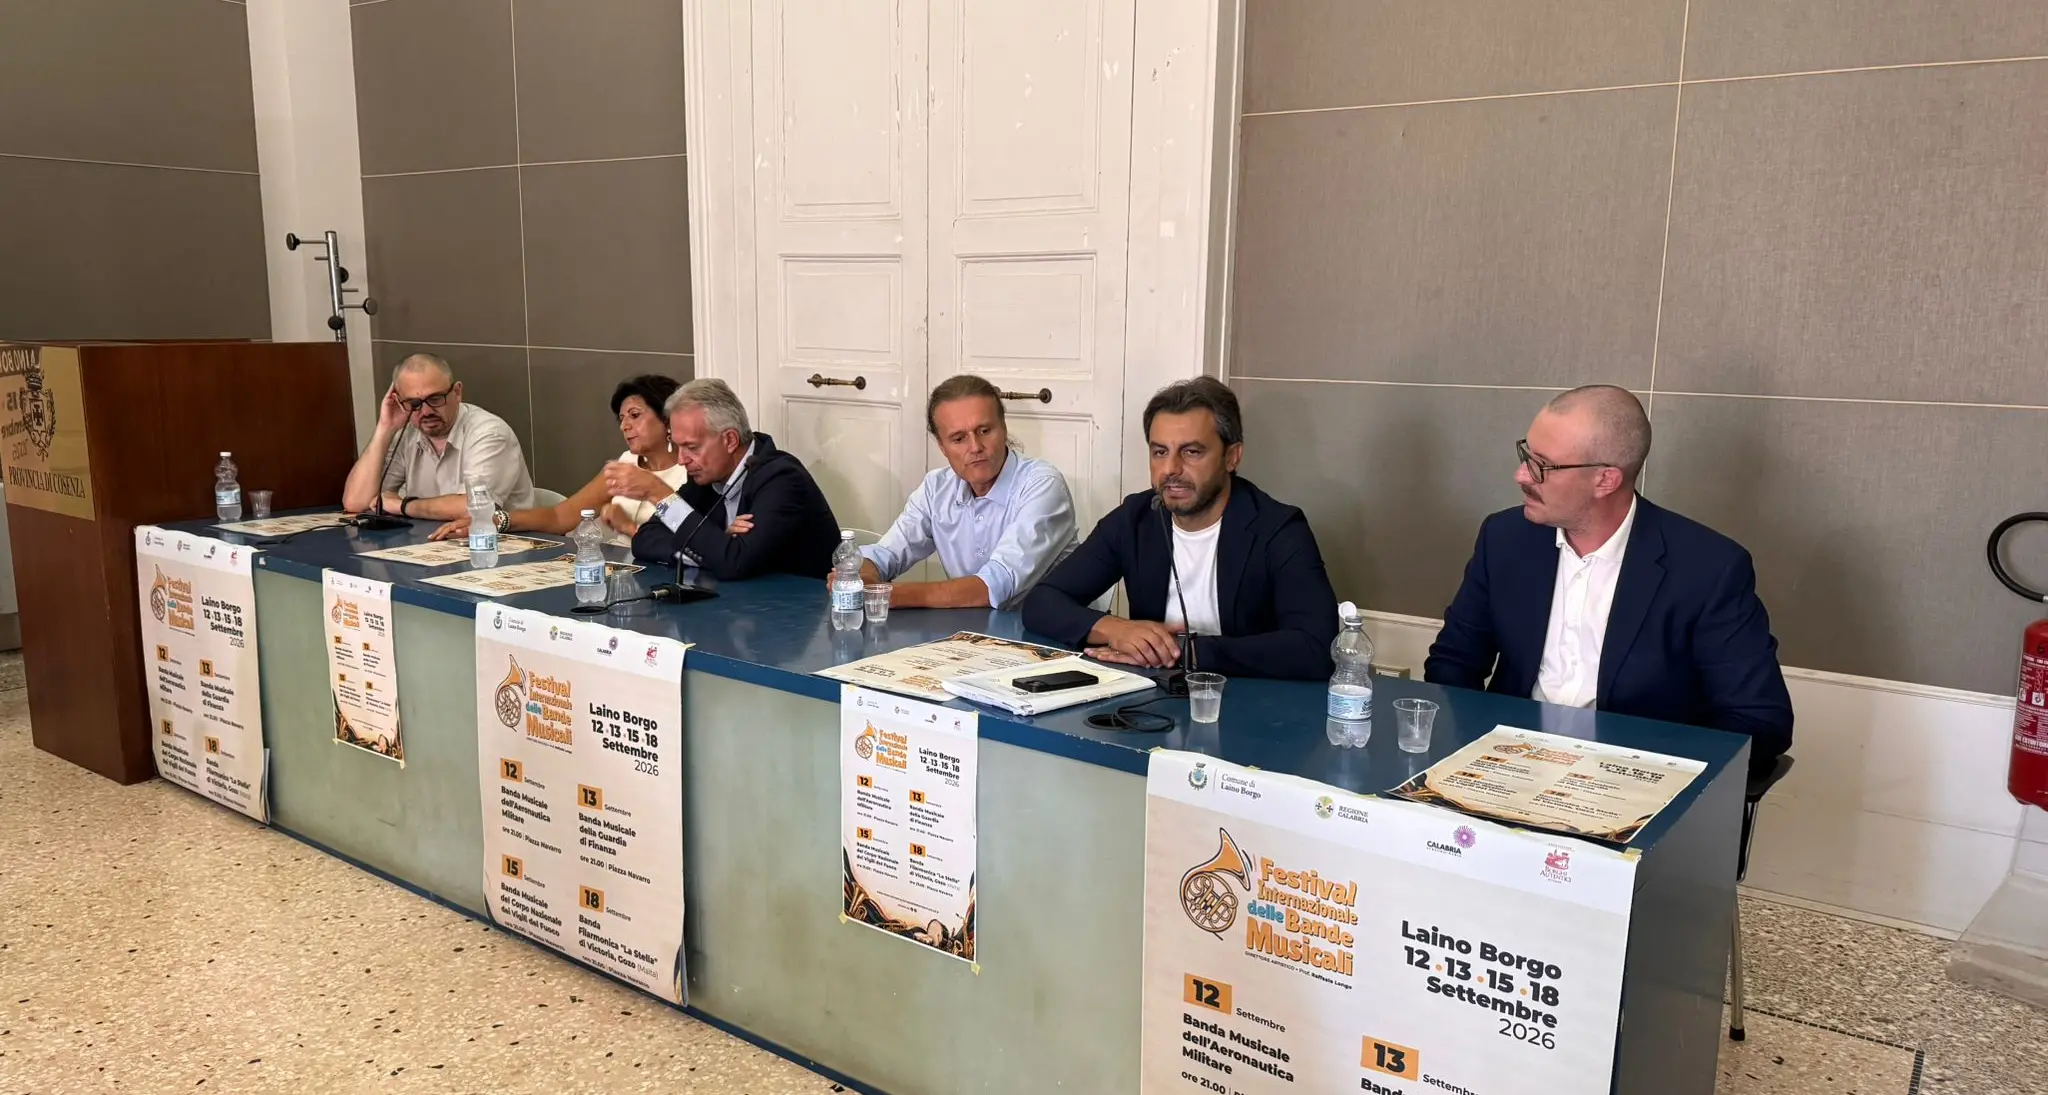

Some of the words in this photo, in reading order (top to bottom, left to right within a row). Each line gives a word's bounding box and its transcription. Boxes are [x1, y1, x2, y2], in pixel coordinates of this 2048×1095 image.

[8, 465, 45, 491] PROVINCIA
[45, 472, 53, 493] DI
[53, 473, 86, 498] COSENZA
[201, 595, 219, 609] Laino
[221, 600, 242, 615] Borgo
[203, 609, 210, 619] 12
[214, 612, 221, 622] 13
[224, 614, 231, 625] 15
[210, 622, 244, 637] Settembre
[159, 647, 166, 660] 12
[202, 661, 210, 675] 13
[528, 671, 571, 698] Festival
[542, 704, 572, 726] Bande
[590, 702, 620, 720] Laino
[623, 711, 658, 731] Borgo
[163, 721, 171, 734] 15
[526, 713, 573, 745] Musicali
[592, 719, 604, 734] 12
[610, 723, 622, 738] 13
[627, 728, 640, 743] 15
[645, 733, 659, 748] 18
[208, 738, 217, 753] 18
[602, 737, 659, 762] Settembre
[919, 747, 938, 758] Laino
[940, 752, 960, 764] Borgo
[504, 761, 518, 779] 12
[634, 759, 660, 777] 2026
[920, 755, 928, 764] 12
[931, 758, 938, 767] 13
[941, 761, 949, 770] 15
[952, 764, 960, 773] 18
[926, 765, 960, 780] Settembre
[860, 776, 869, 787] 12
[1220, 782, 1240, 794] Laino
[1241, 787, 1262, 799] Borgo
[1221, 773, 1248, 787] Comune
[1249, 780, 1256, 789] di
[501, 786, 521, 799] Banda
[521, 793, 548, 811] Musicale
[583, 788, 597, 806] 13
[912, 791, 922, 802] 13
[502, 809, 525, 824] Militare
[604, 803, 632, 818] Settembre
[1337, 811, 1369, 824] CALABRIA
[1338, 805, 1369, 818] REGIONE
[579, 812, 602, 827] Banda
[603, 820, 637, 838] Musicale
[860, 828, 869, 839] 15
[580, 825, 597, 838] della
[598, 831, 627, 848] Guardia
[580, 837, 587, 846] di
[588, 840, 617, 856] Finanza
[540, 841, 562, 855] Navarro
[912, 844, 923, 856] 18
[1426, 840, 1462, 855] CALABRIA
[506, 858, 519, 876] 15
[580, 855, 590, 863] ore
[590, 857, 604, 868] 21.00
[608, 863, 626, 876] Piazza
[627, 871, 651, 885] Navarro
[1260, 857, 1358, 907] Festival
[501, 882, 521, 897] Banda
[521, 890, 548, 909] Musicale
[585, 889, 600, 909] 18
[1257, 879, 1359, 926] Internazionale
[501, 894, 510, 904] del
[511, 898, 530, 913] Corpo
[530, 907, 562, 927] Nazionale
[605, 906, 632, 922] Settembre
[511, 909, 528, 923] Vigili
[540, 922, 560, 937] Fuoco
[578, 914, 601, 930] Banda
[1247, 900, 1285, 923] delle
[1285, 908, 1355, 948] Bande
[578, 926, 619, 950] Filarmonica
[1246, 916, 1354, 977] Musicali
[579, 939, 586, 948] di
[587, 941, 617, 963] Victoria,
[617, 955, 636, 969] Gozo
[637, 962, 659, 980] (Malta)
[1402, 920, 1472, 955] Laino
[1479, 941, 1562, 980] Borgo
[1404, 945, 1430, 970] 12
[1444, 956, 1472, 981] 13
[1486, 968, 1514, 993] 15
[1529, 980, 1560, 1007] 18
[1193, 979, 1220, 1008] 12
[1426, 975, 1558, 1029] Settembre
[1236, 1007, 1286, 1033] Settembre
[1183, 1013, 1226, 1038] Banda
[1229, 1029, 1291, 1063] Musicale
[1499, 1018, 1556, 1050] 2026
[1182, 1030, 1295, 1083] dell'Aeronautica
[1182, 1046, 1233, 1075] Militare
[1374, 1042, 1406, 1073] 13
[1181, 1071, 1198, 1083] ore
[1200, 1077, 1226, 1095] 21.00
[1361, 1077, 1406, 1095] Band
